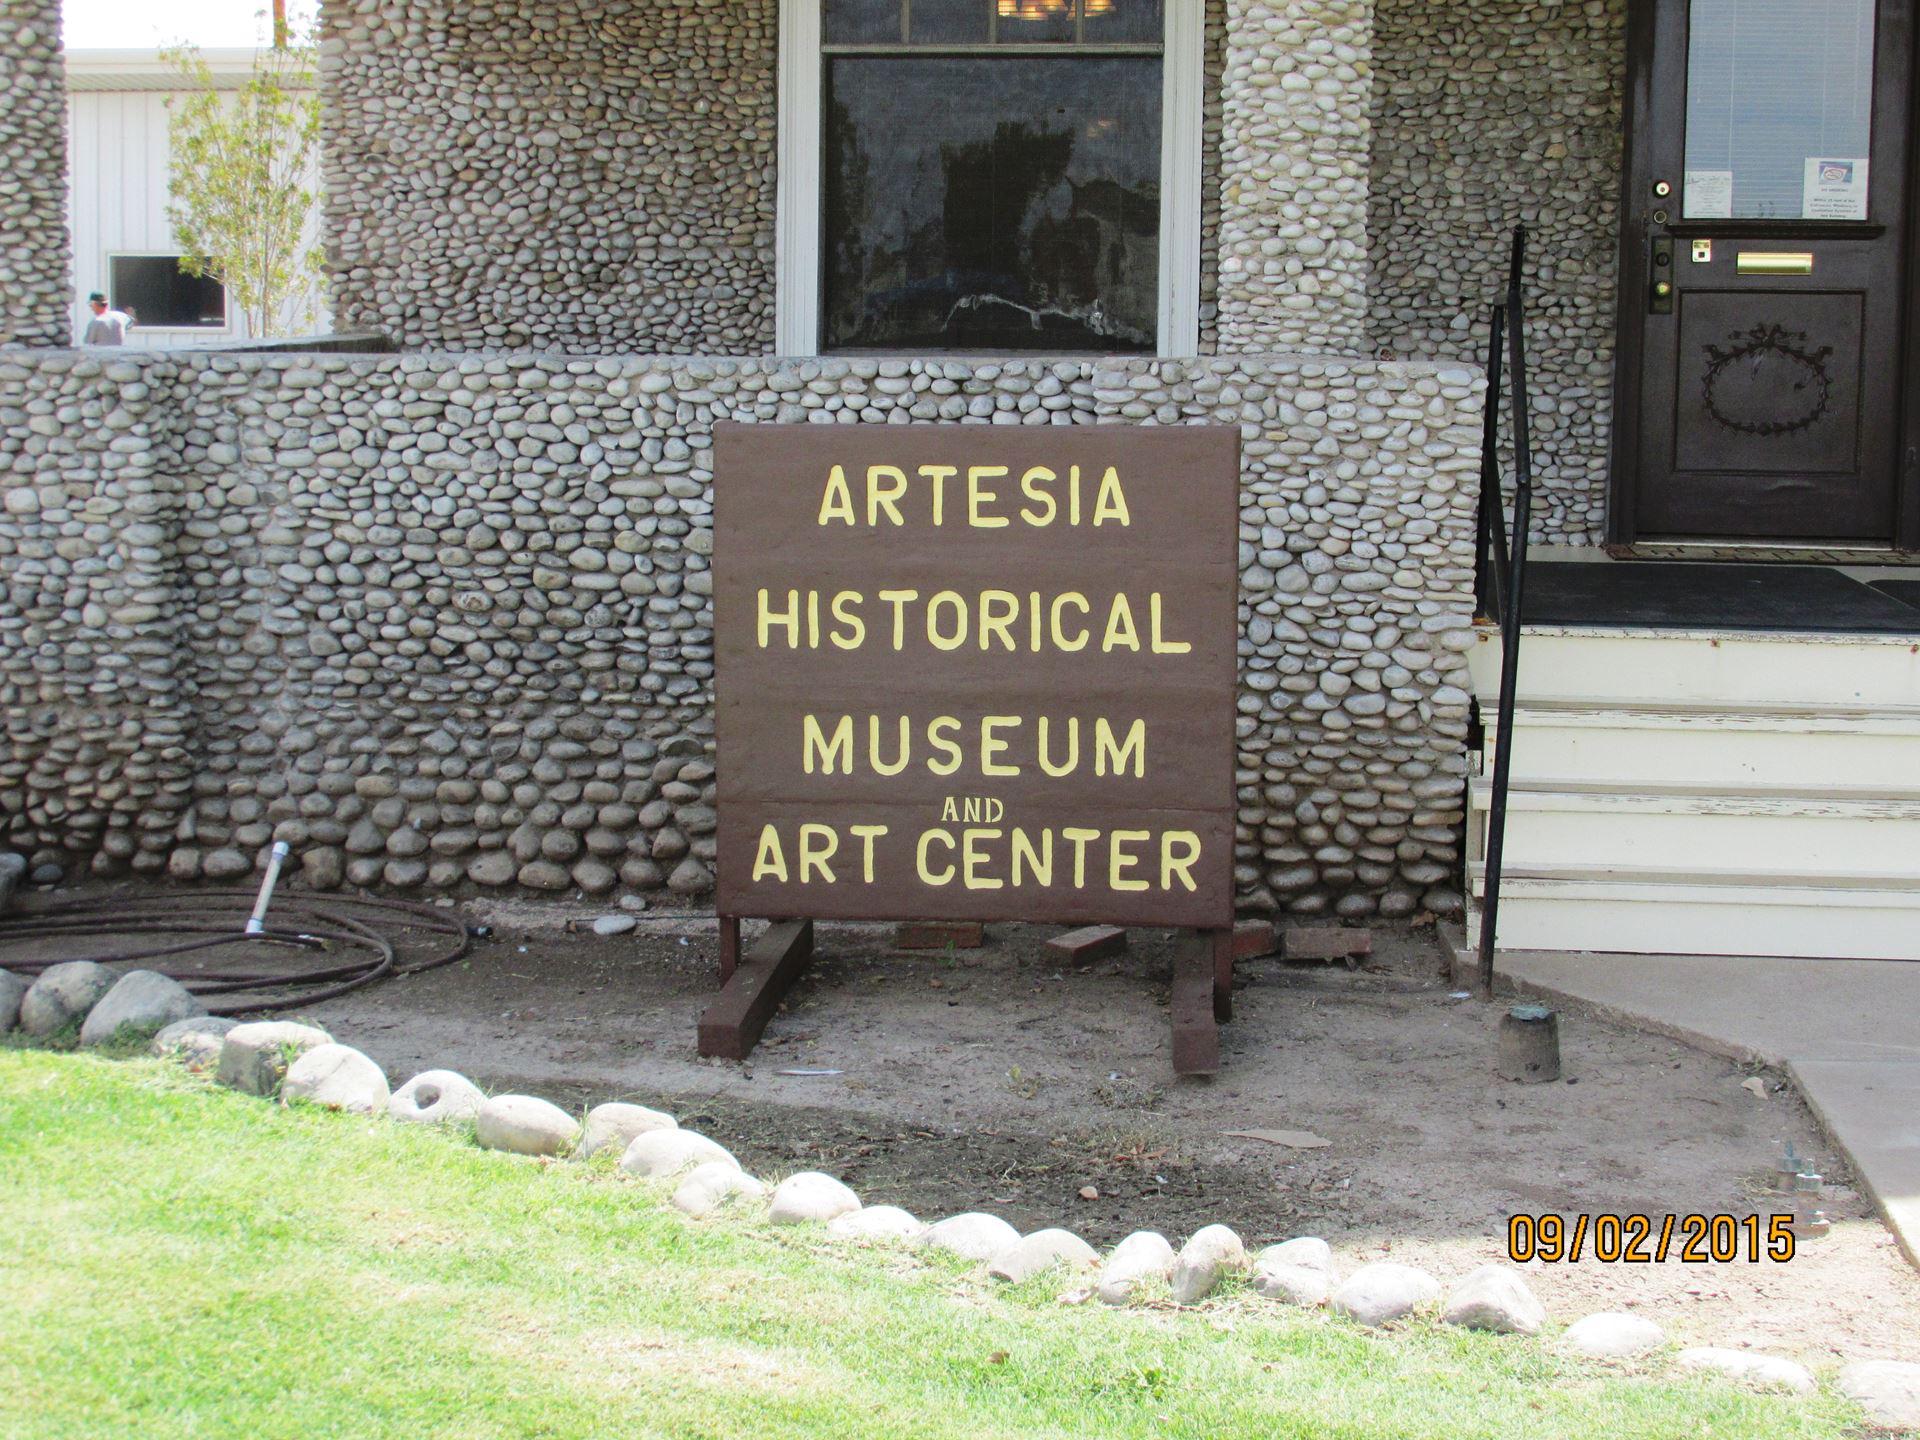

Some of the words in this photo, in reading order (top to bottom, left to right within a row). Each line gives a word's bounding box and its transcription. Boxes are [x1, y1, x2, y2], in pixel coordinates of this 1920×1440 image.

[818, 464, 1131, 528] ARTESIA
[757, 588, 1192, 654] HISTORICAL
[803, 714, 1146, 778] MUSEUM
[941, 796, 1004, 823] AND
[752, 823, 889, 884] ART
[916, 827, 1202, 892] CENTER
